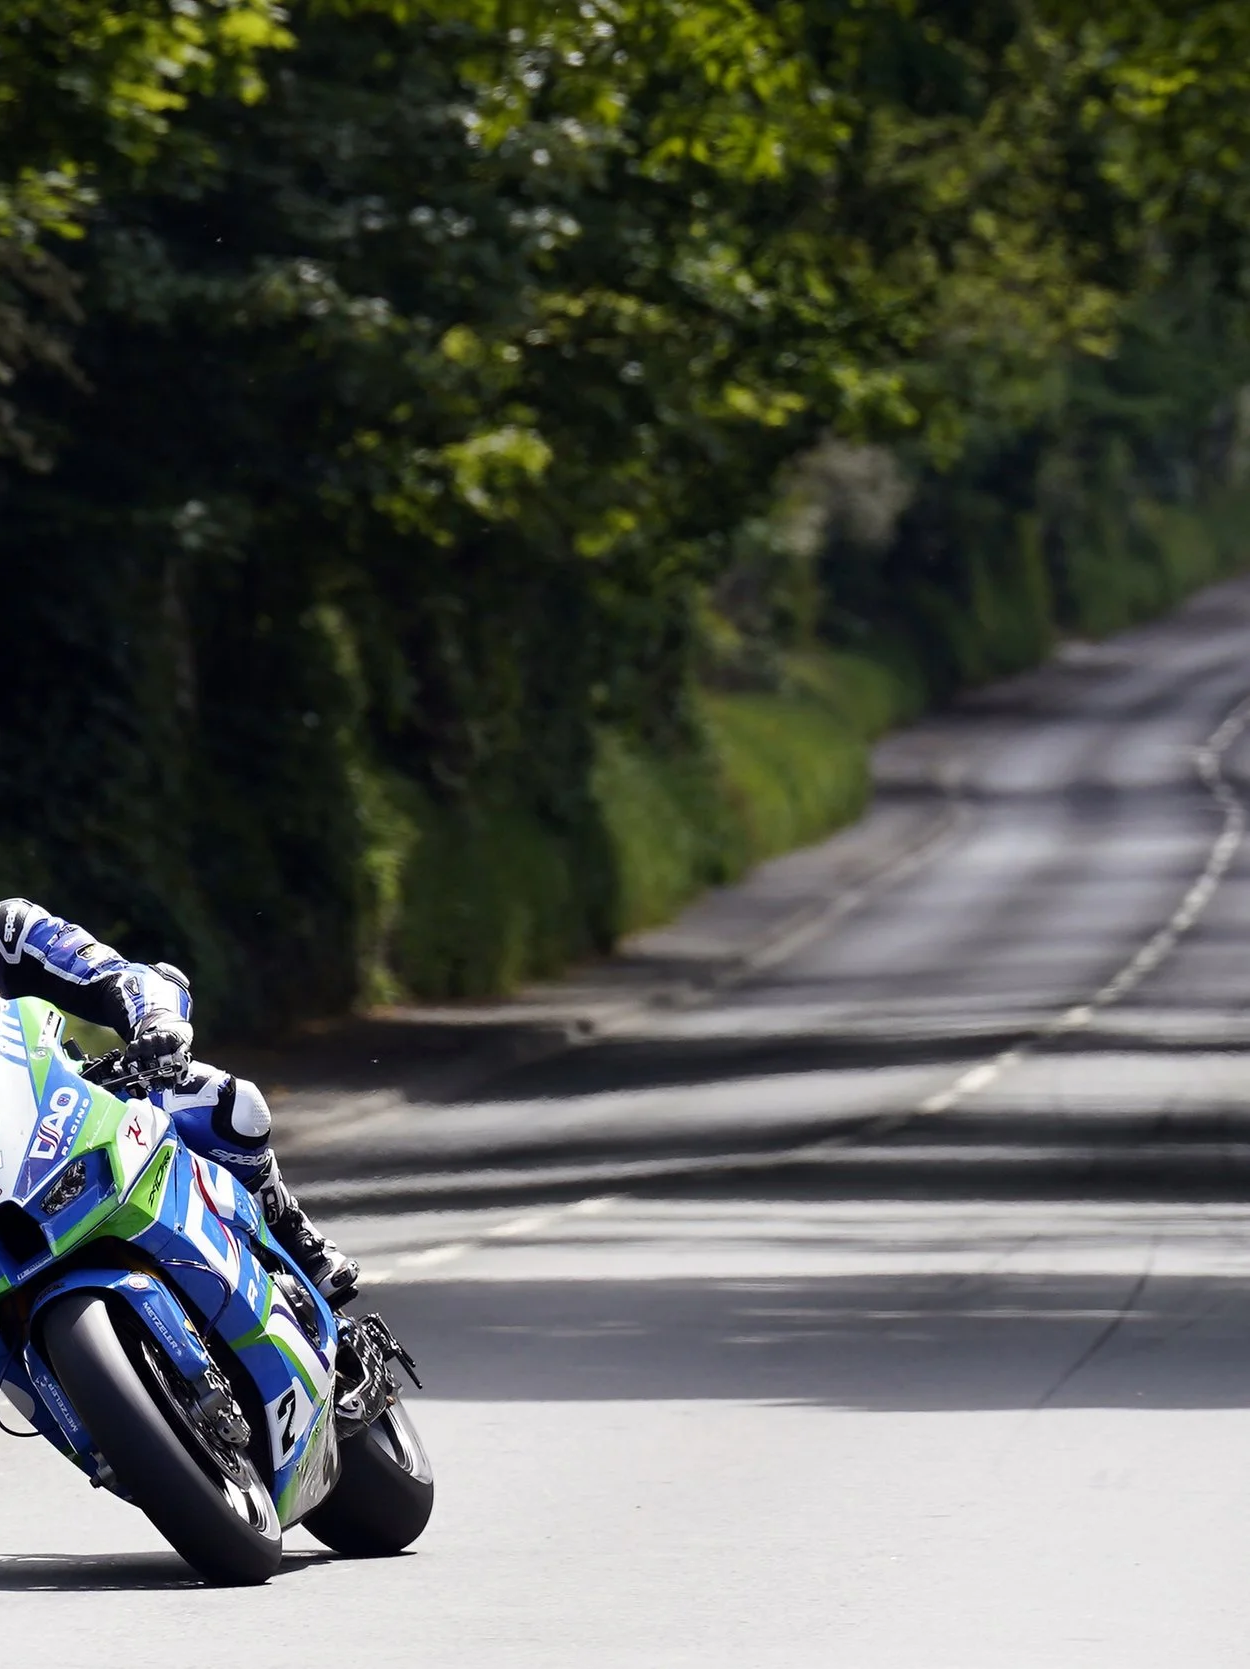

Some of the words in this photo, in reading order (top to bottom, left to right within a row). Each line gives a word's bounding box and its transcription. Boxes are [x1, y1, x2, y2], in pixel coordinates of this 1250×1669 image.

[61, 1098, 90, 1155] RACING
[143, 1302, 178, 1349] METZELER
[48, 1384, 78, 1432] METZELER
[276, 1388, 297, 1457] 2
